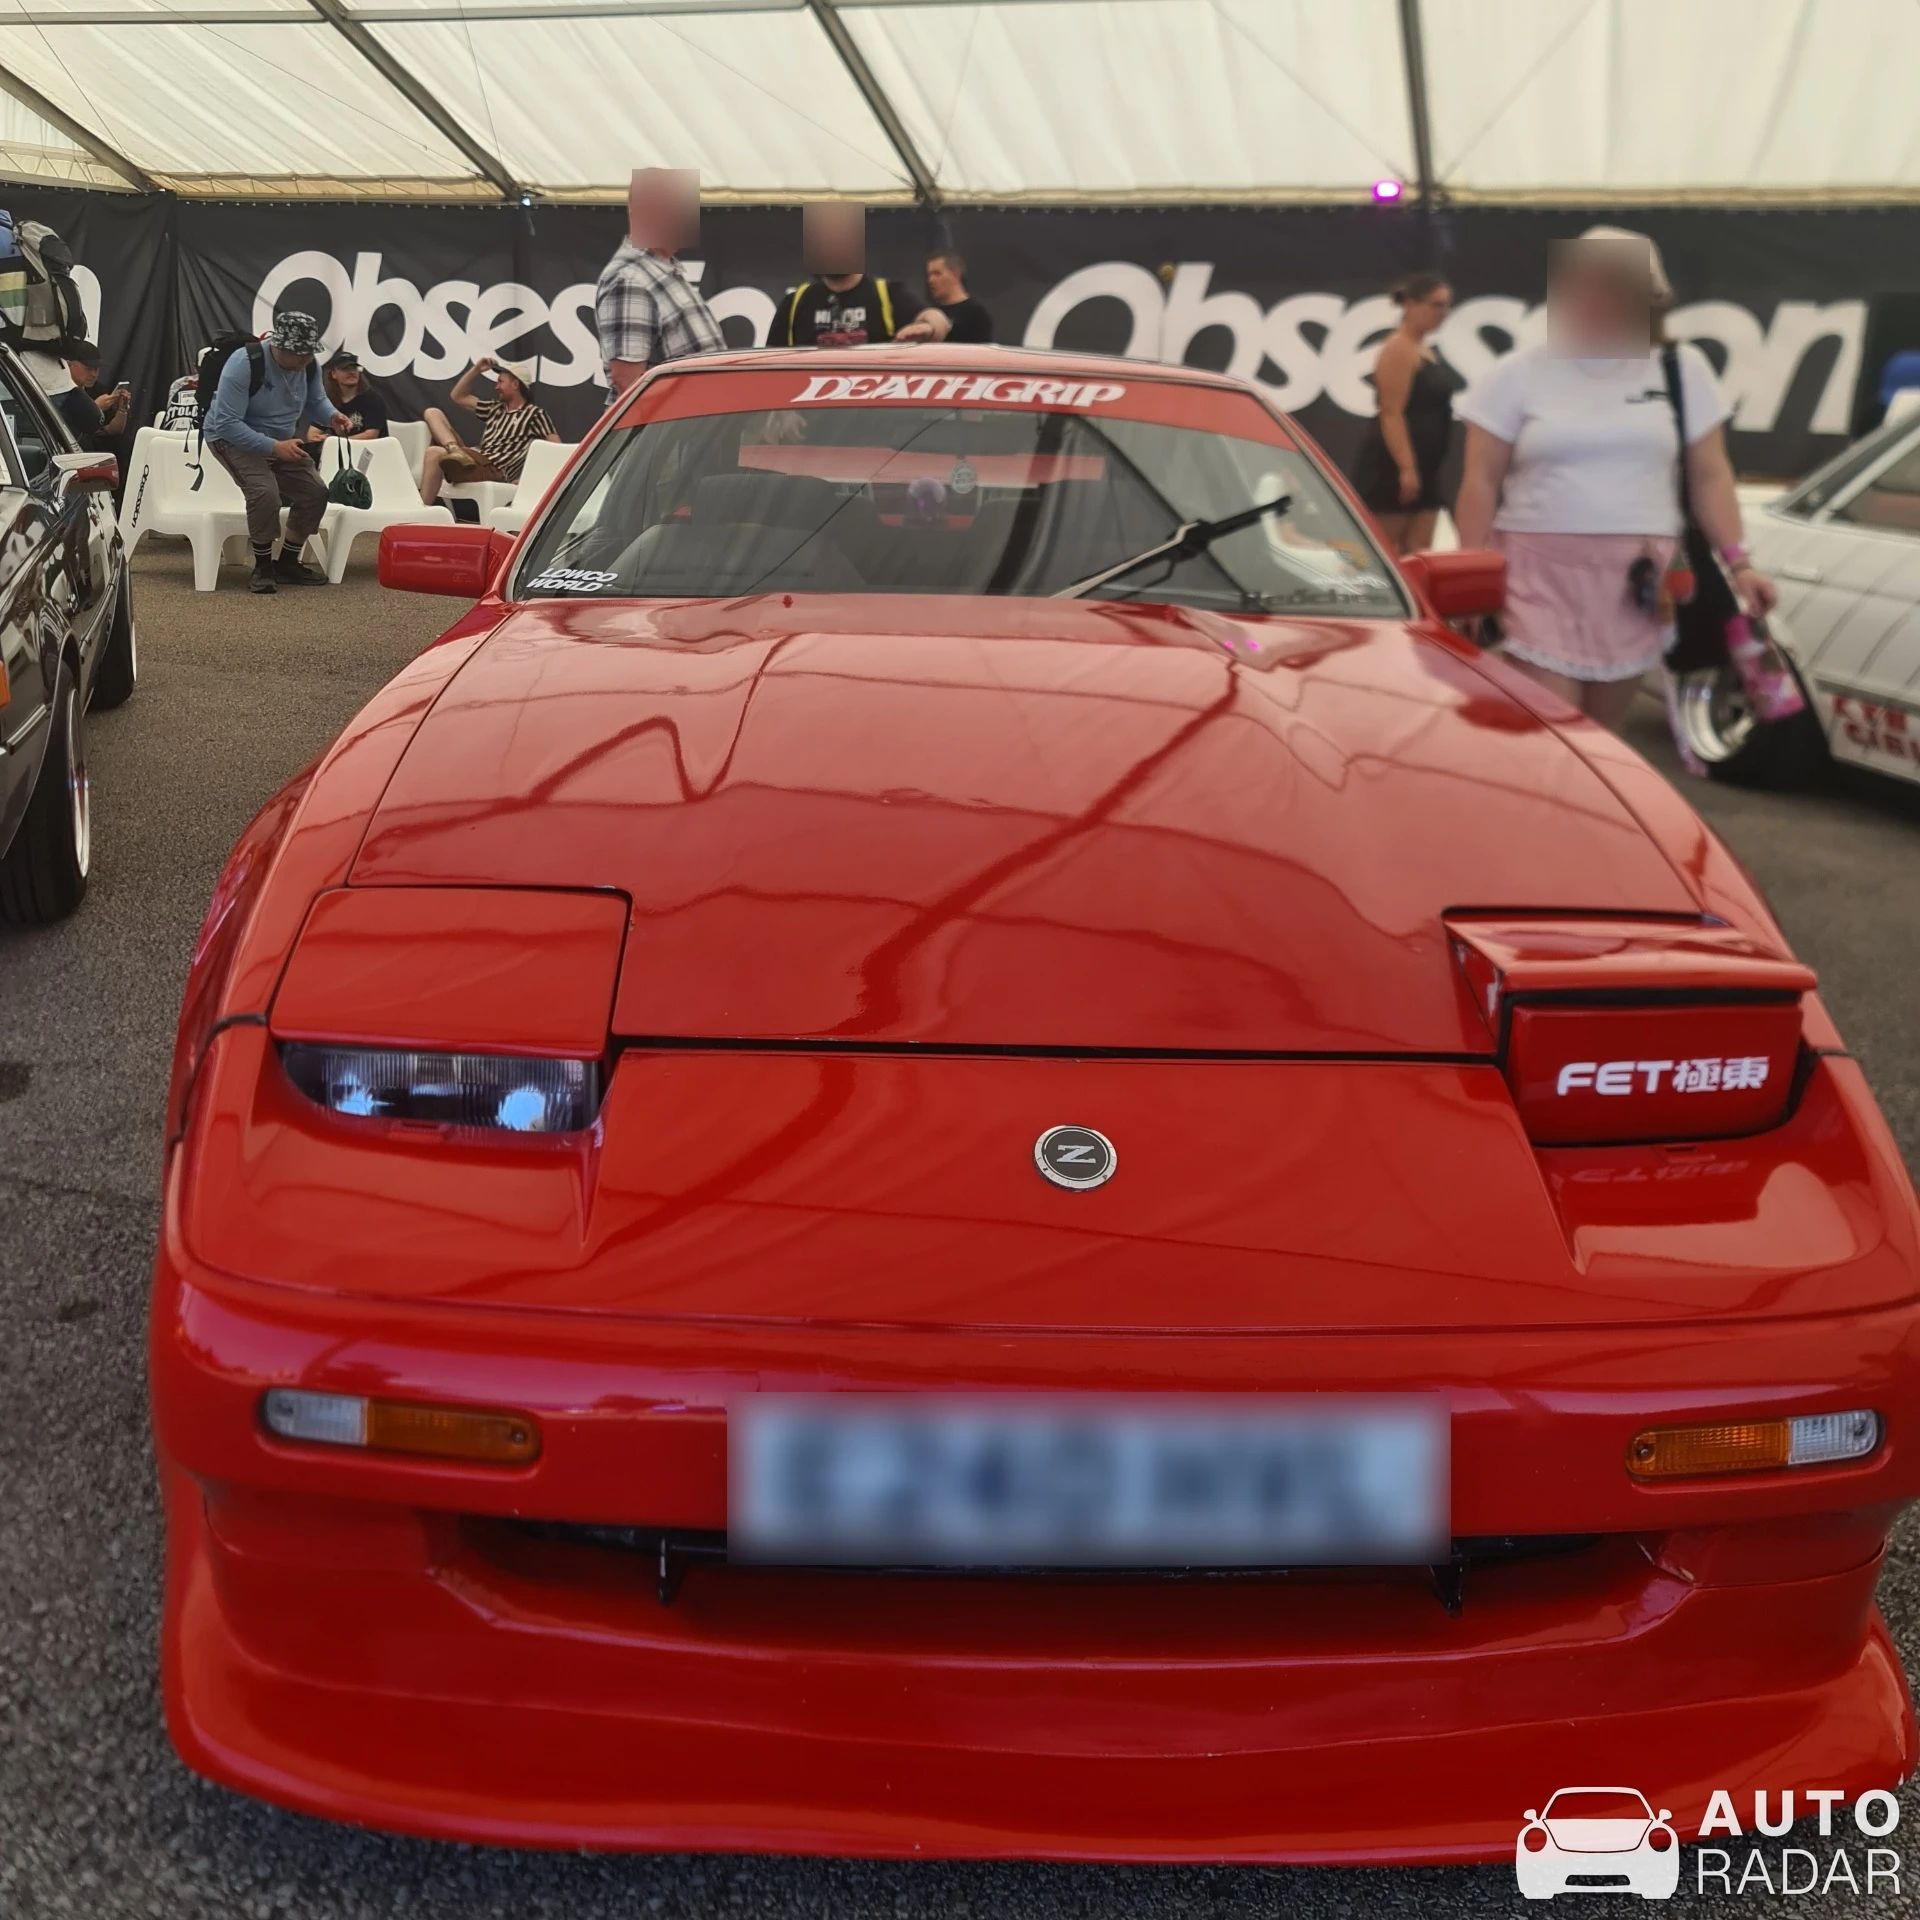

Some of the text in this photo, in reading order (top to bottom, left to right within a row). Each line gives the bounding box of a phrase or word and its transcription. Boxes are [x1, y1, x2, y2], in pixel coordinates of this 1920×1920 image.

[790, 375, 1126, 407] DEATHGRIP
[131, 464, 149, 528] Obsession
[526, 578, 603, 591] WORLD
[538, 567, 618, 582] LOWCO
[1556, 1056, 1769, 1096] FET極東
[1056, 1144, 1097, 1164] Z
